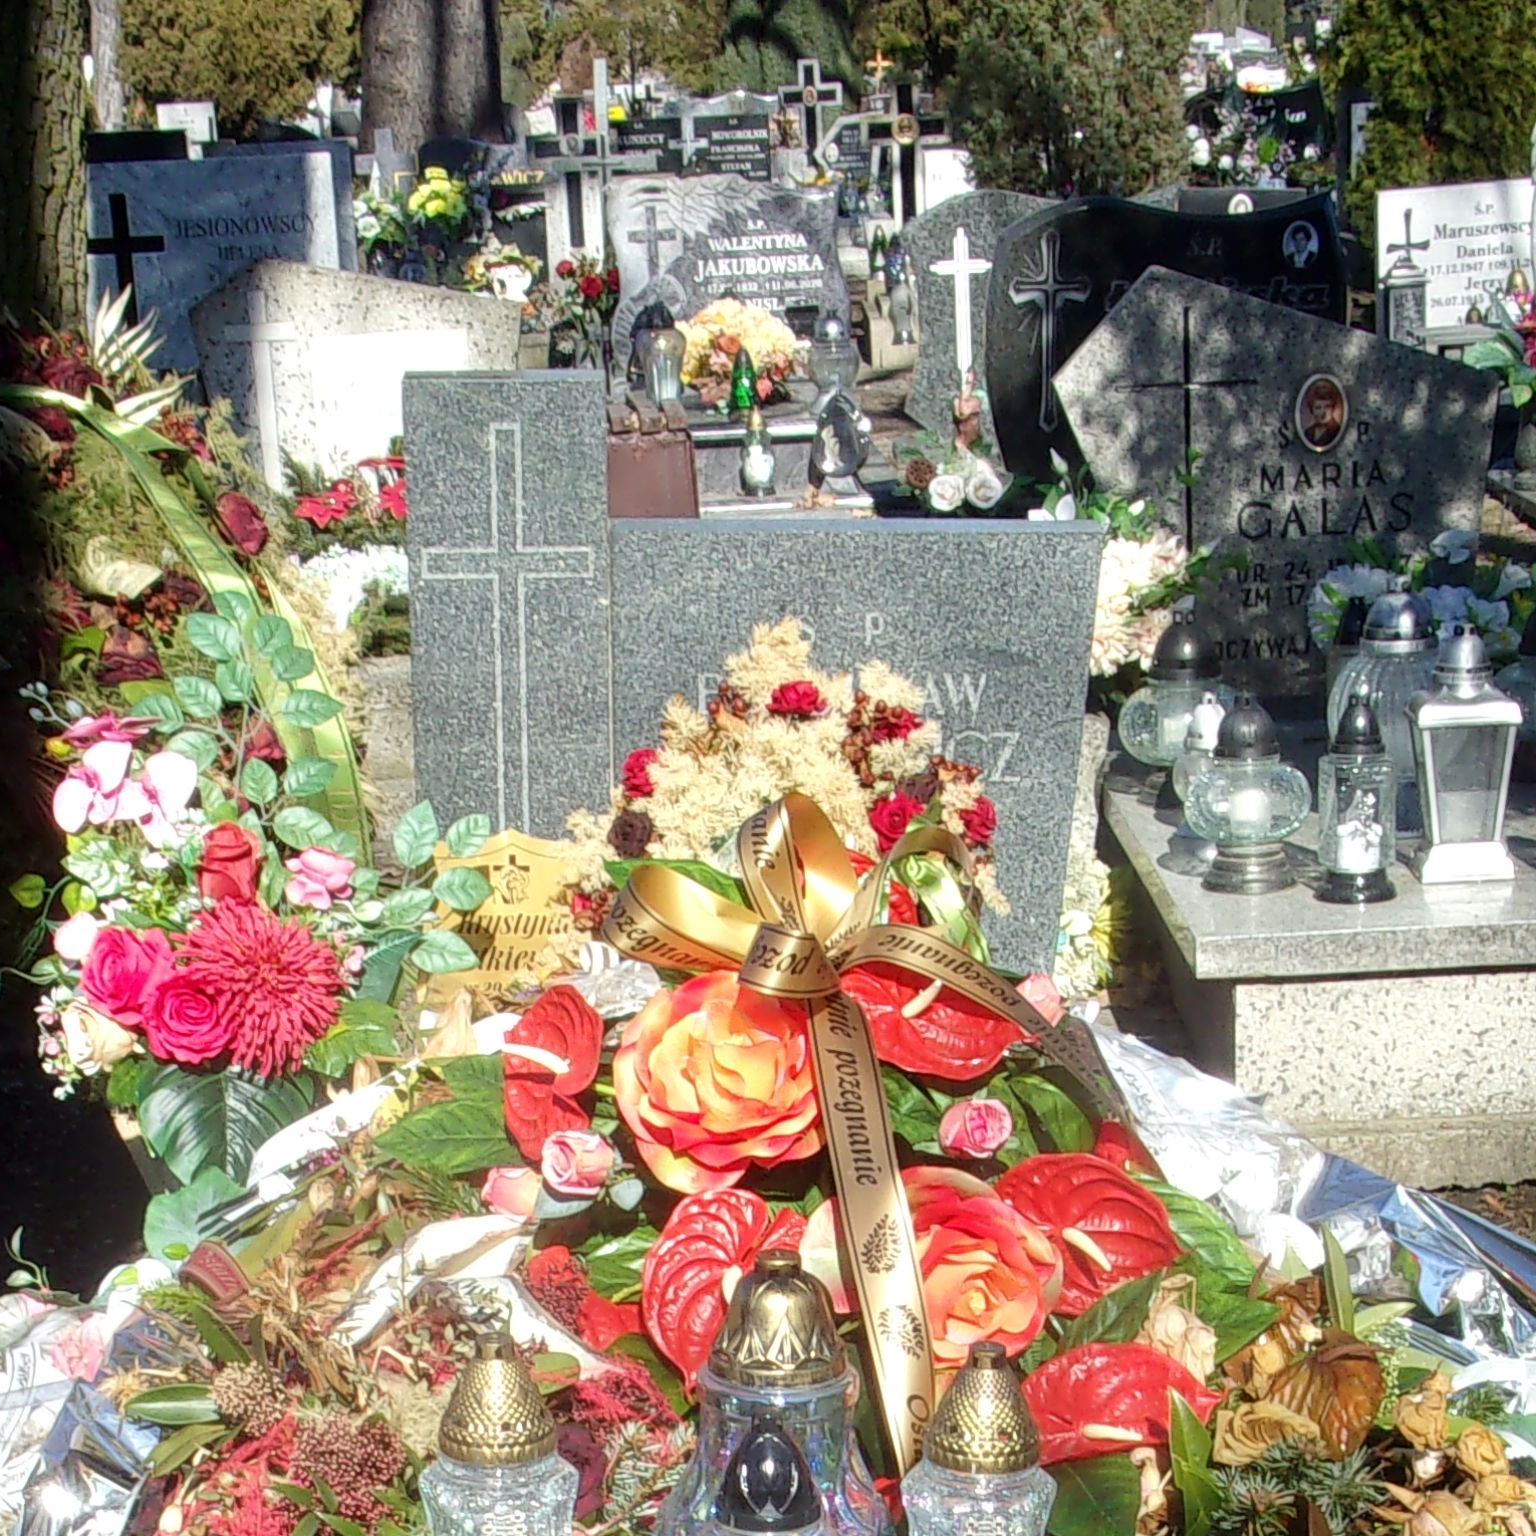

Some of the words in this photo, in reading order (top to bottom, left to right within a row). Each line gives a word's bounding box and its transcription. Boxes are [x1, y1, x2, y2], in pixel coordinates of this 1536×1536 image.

[173, 211, 318, 240] JESIONOWSCY
[706, 232, 809, 252] WALENTYNA
[1455, 241, 1515, 260] Daniela
[693, 253, 825, 284] JAKUBOWSKA
[1258, 458, 1388, 494] MARIA
[1236, 491, 1416, 542] GALAS
